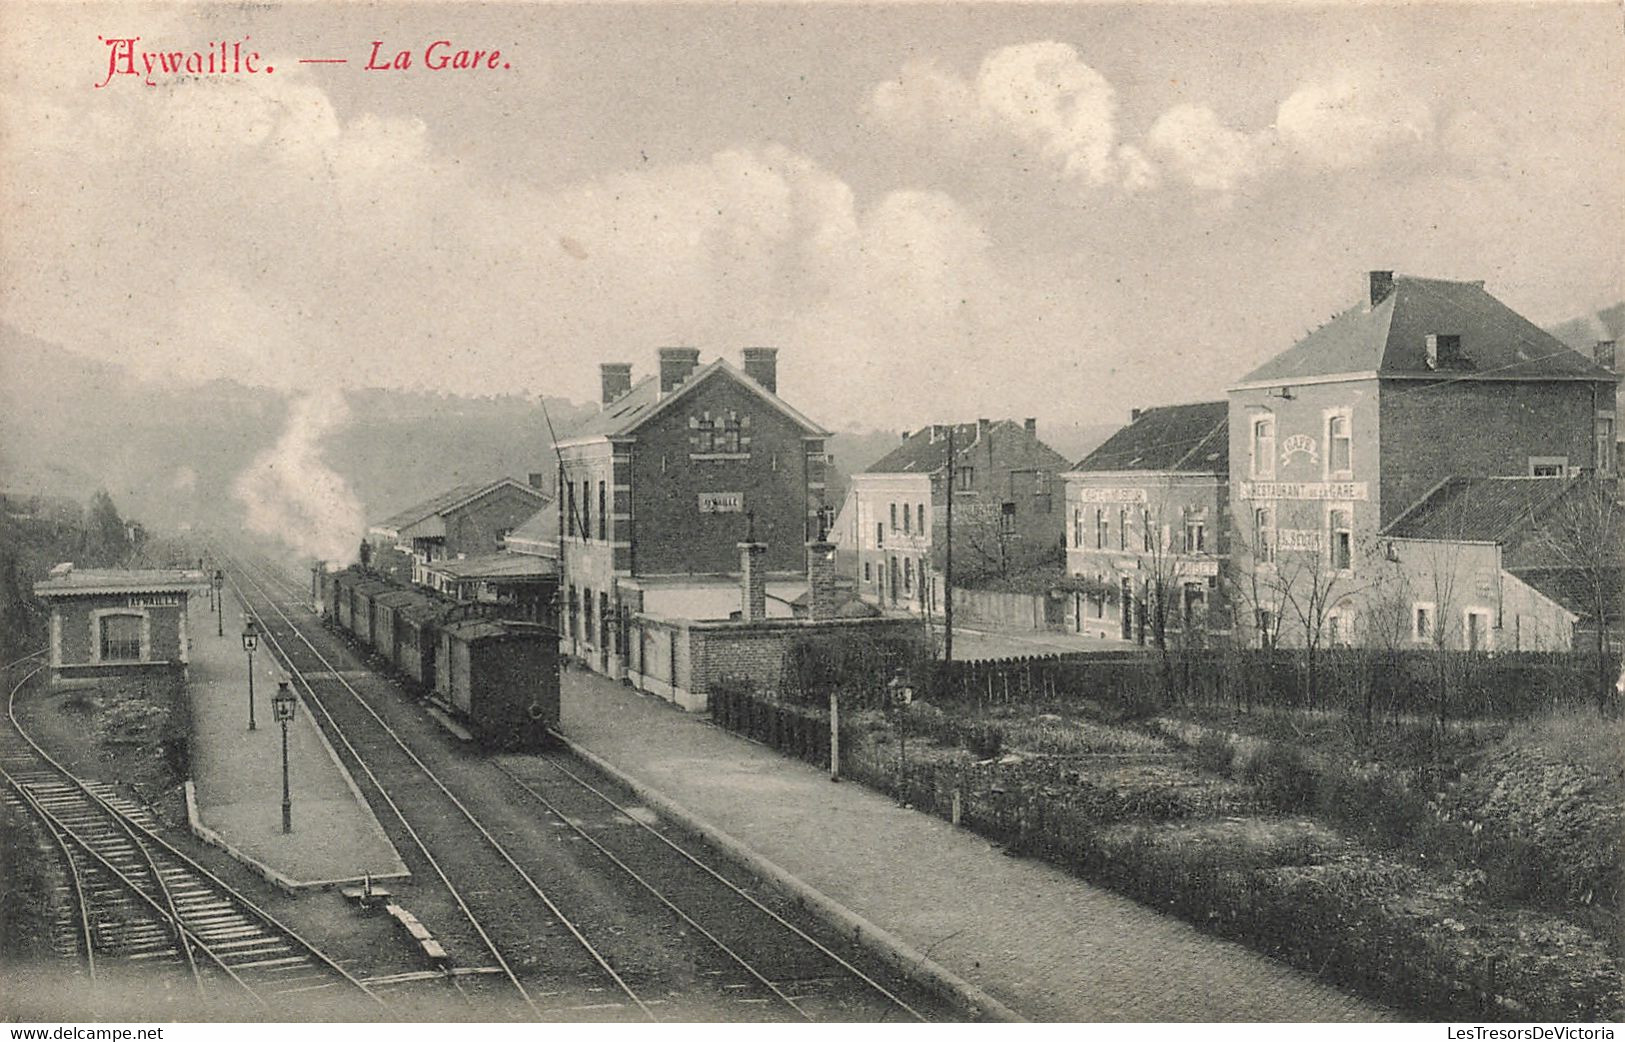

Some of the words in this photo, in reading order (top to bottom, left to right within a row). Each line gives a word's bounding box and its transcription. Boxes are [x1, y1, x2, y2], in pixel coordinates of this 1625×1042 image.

[1251, 484, 1305, 497] RESTAURANT
[1329, 484, 1355, 497] GARE
[129, 596, 178, 606] AYWAILLE
